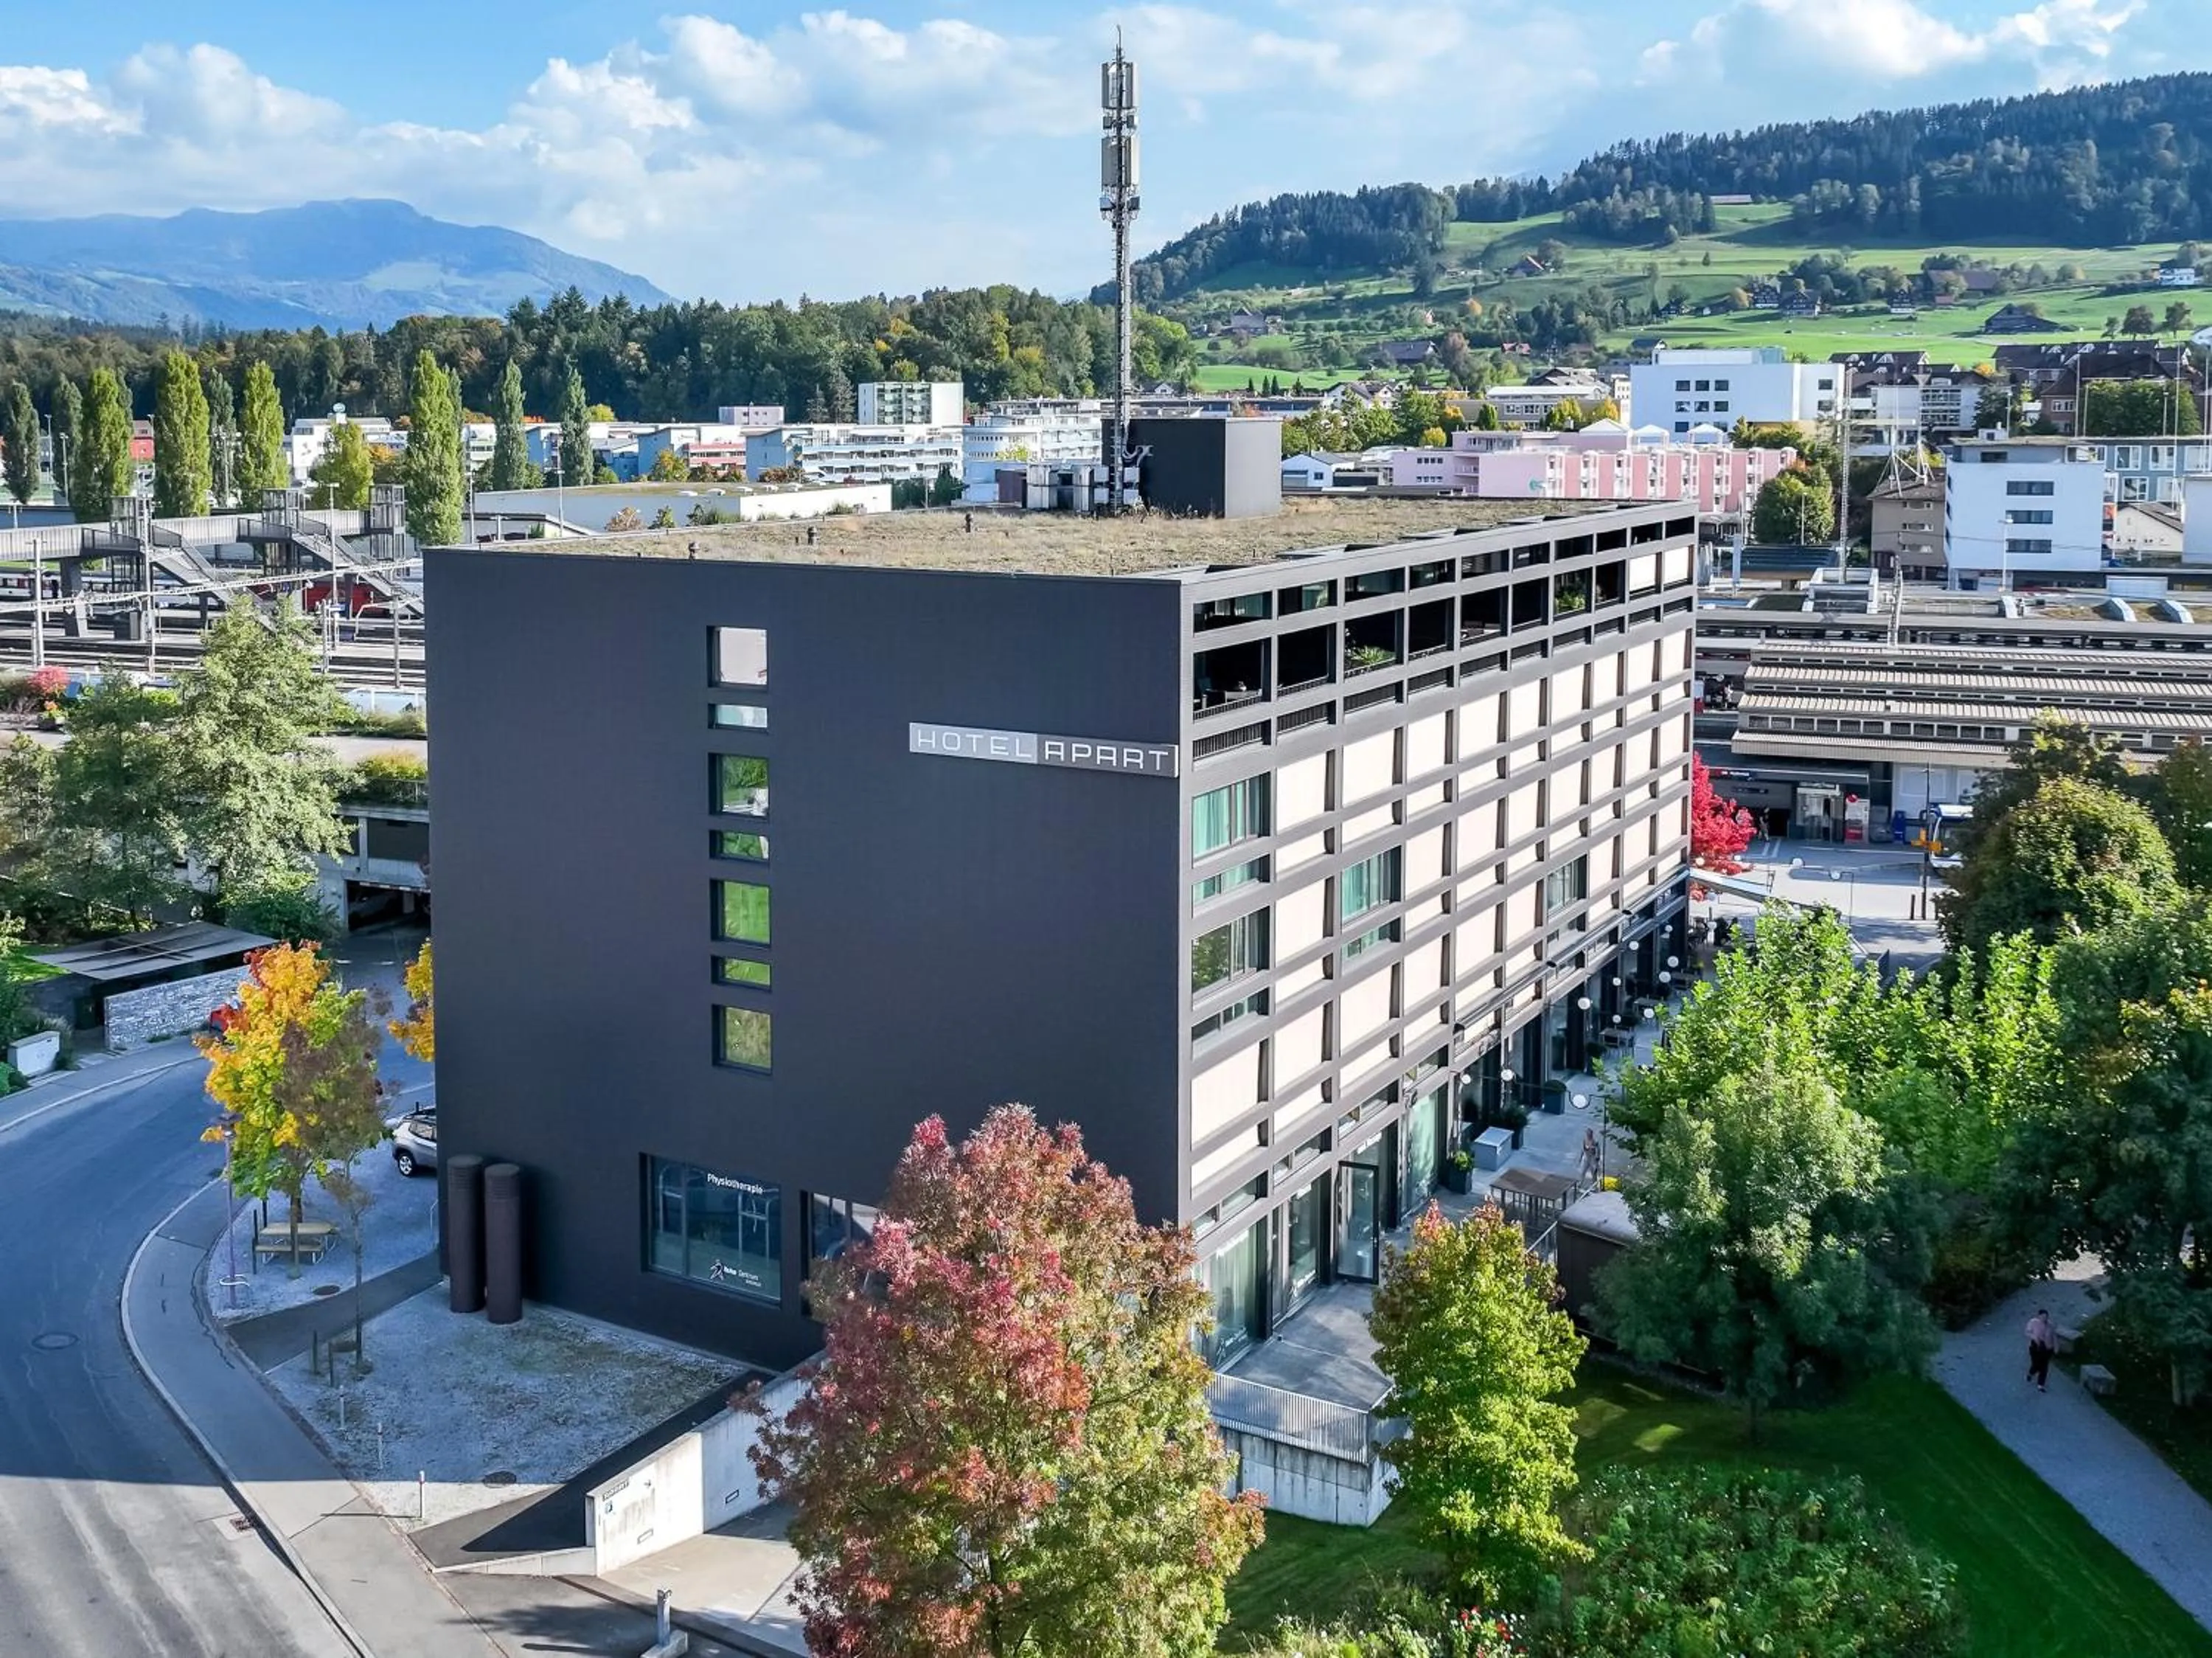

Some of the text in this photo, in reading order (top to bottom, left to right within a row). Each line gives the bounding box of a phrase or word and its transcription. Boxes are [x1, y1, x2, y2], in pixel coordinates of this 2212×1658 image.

[918, 729, 1169, 771] HOTEL APART
[707, 1173, 763, 1194] Physiotherapie
